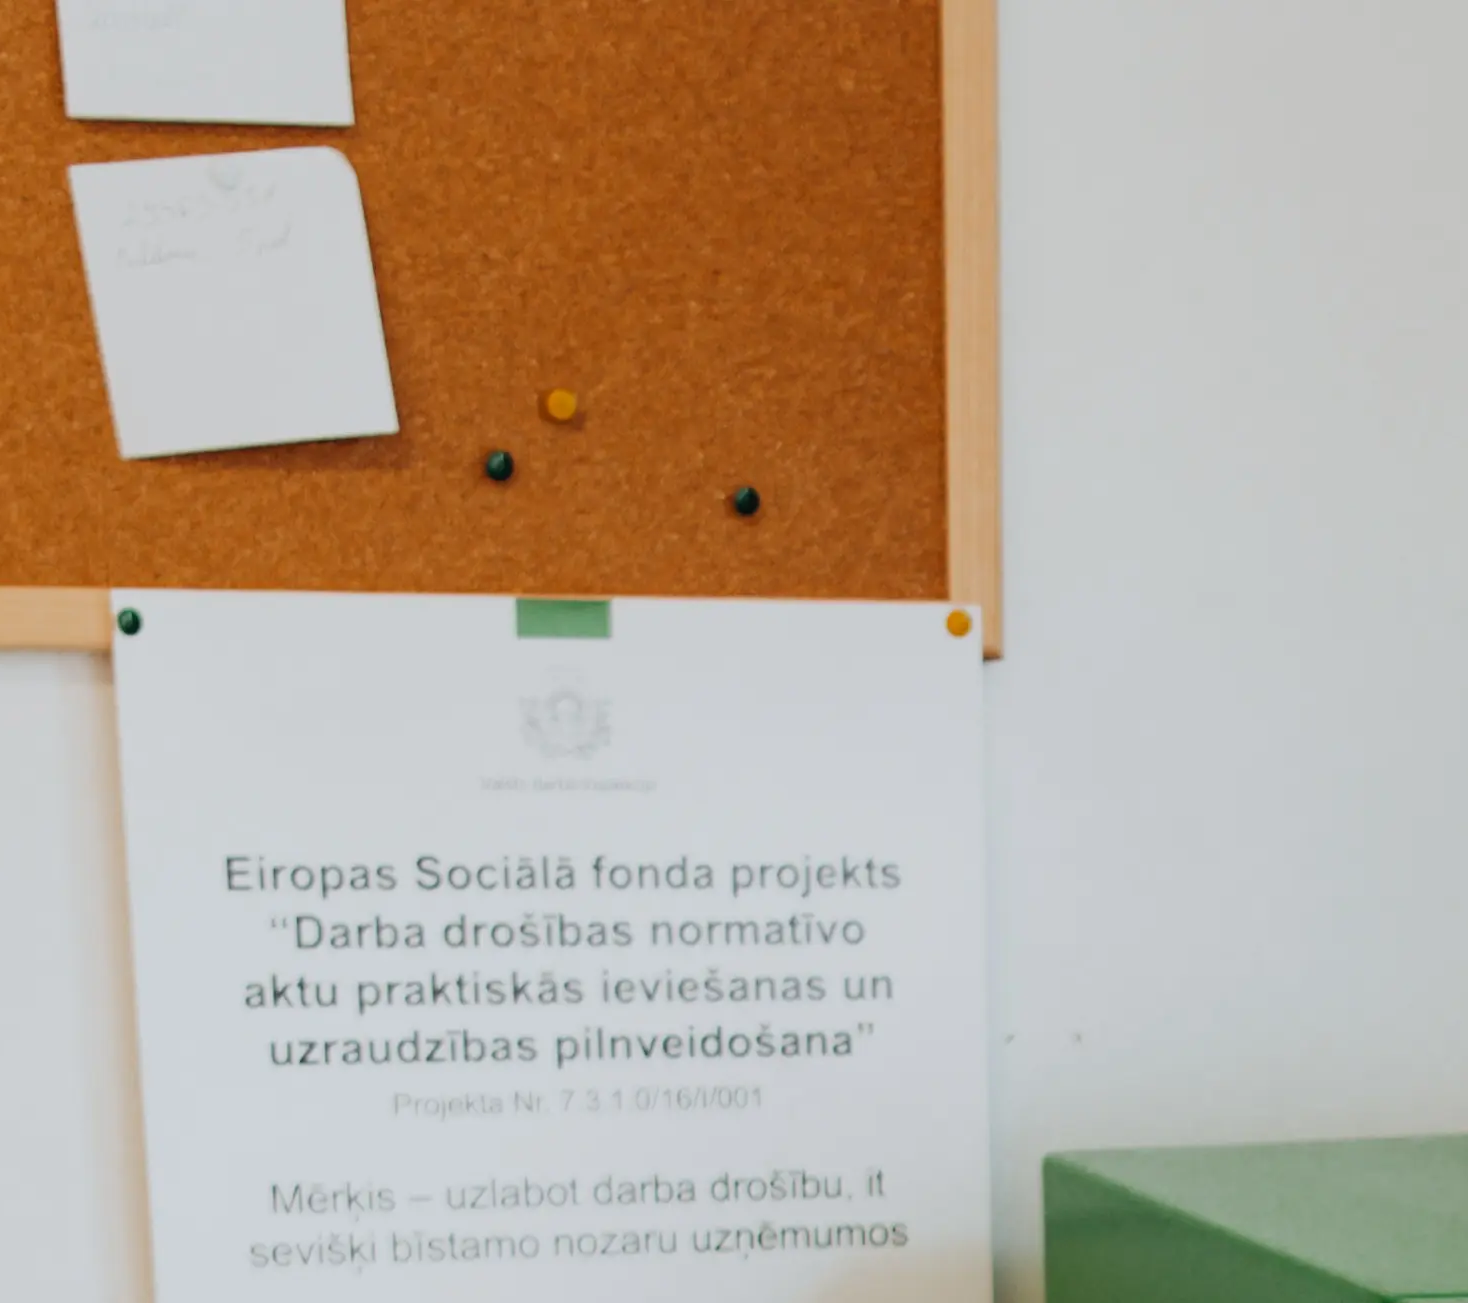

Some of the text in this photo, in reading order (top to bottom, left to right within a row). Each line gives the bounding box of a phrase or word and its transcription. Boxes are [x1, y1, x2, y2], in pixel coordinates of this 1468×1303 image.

[225, 854, 902, 899] Eiropas Sociālā fonda projekts
[443, 911, 634, 949] drošības
[650, 911, 866, 946] normatīvo
[244, 966, 894, 1016] aktu praktiskās ieviešanas un
[269, 1028, 539, 1066] uzraudzības
[392, 1091, 504, 1121] Projekta
[270, 1180, 397, 1224] Mērķis
[445, 1176, 581, 1211] uzlabot
[592, 1173, 697, 1206] darba
[867, 1168, 886, 1198] it
[248, 1219, 910, 1276] sevišķi bīstamo nozaru uzņēmumos
